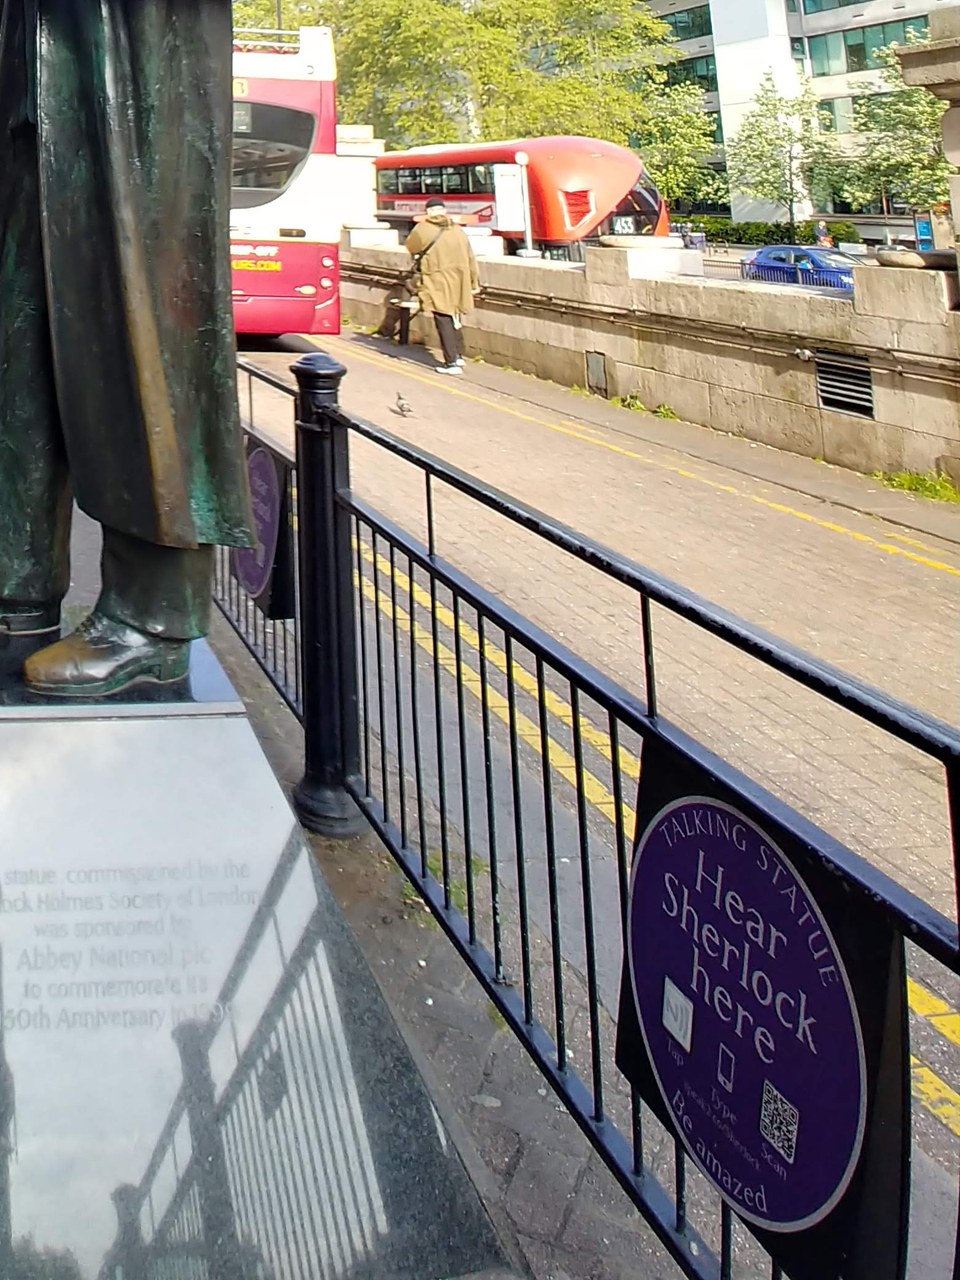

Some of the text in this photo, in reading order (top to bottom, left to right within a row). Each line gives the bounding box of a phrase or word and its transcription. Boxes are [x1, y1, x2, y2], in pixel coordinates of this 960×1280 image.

[614, 217, 634, 234] 453
[4, 867, 57, 886] statue
[222, 858, 251, 880] the
[659, 809, 839, 988] TALKING STATUE
[695, 848, 788, 960] Hear
[33, 920, 69, 938] was
[16, 944, 83, 975] Abbey
[90, 941, 176, 969] National
[662, 872, 818, 1056] Sherlock
[23, 980, 43, 1000] to
[691, 943, 776, 1064] here
[58, 1001, 167, 1029] Anniversary
[666, 1037, 685, 1067] Tap
[711, 1086, 737, 1126] Type
[672, 1089, 769, 1213] Be amazed
[760, 1142, 788, 1181] Scan
